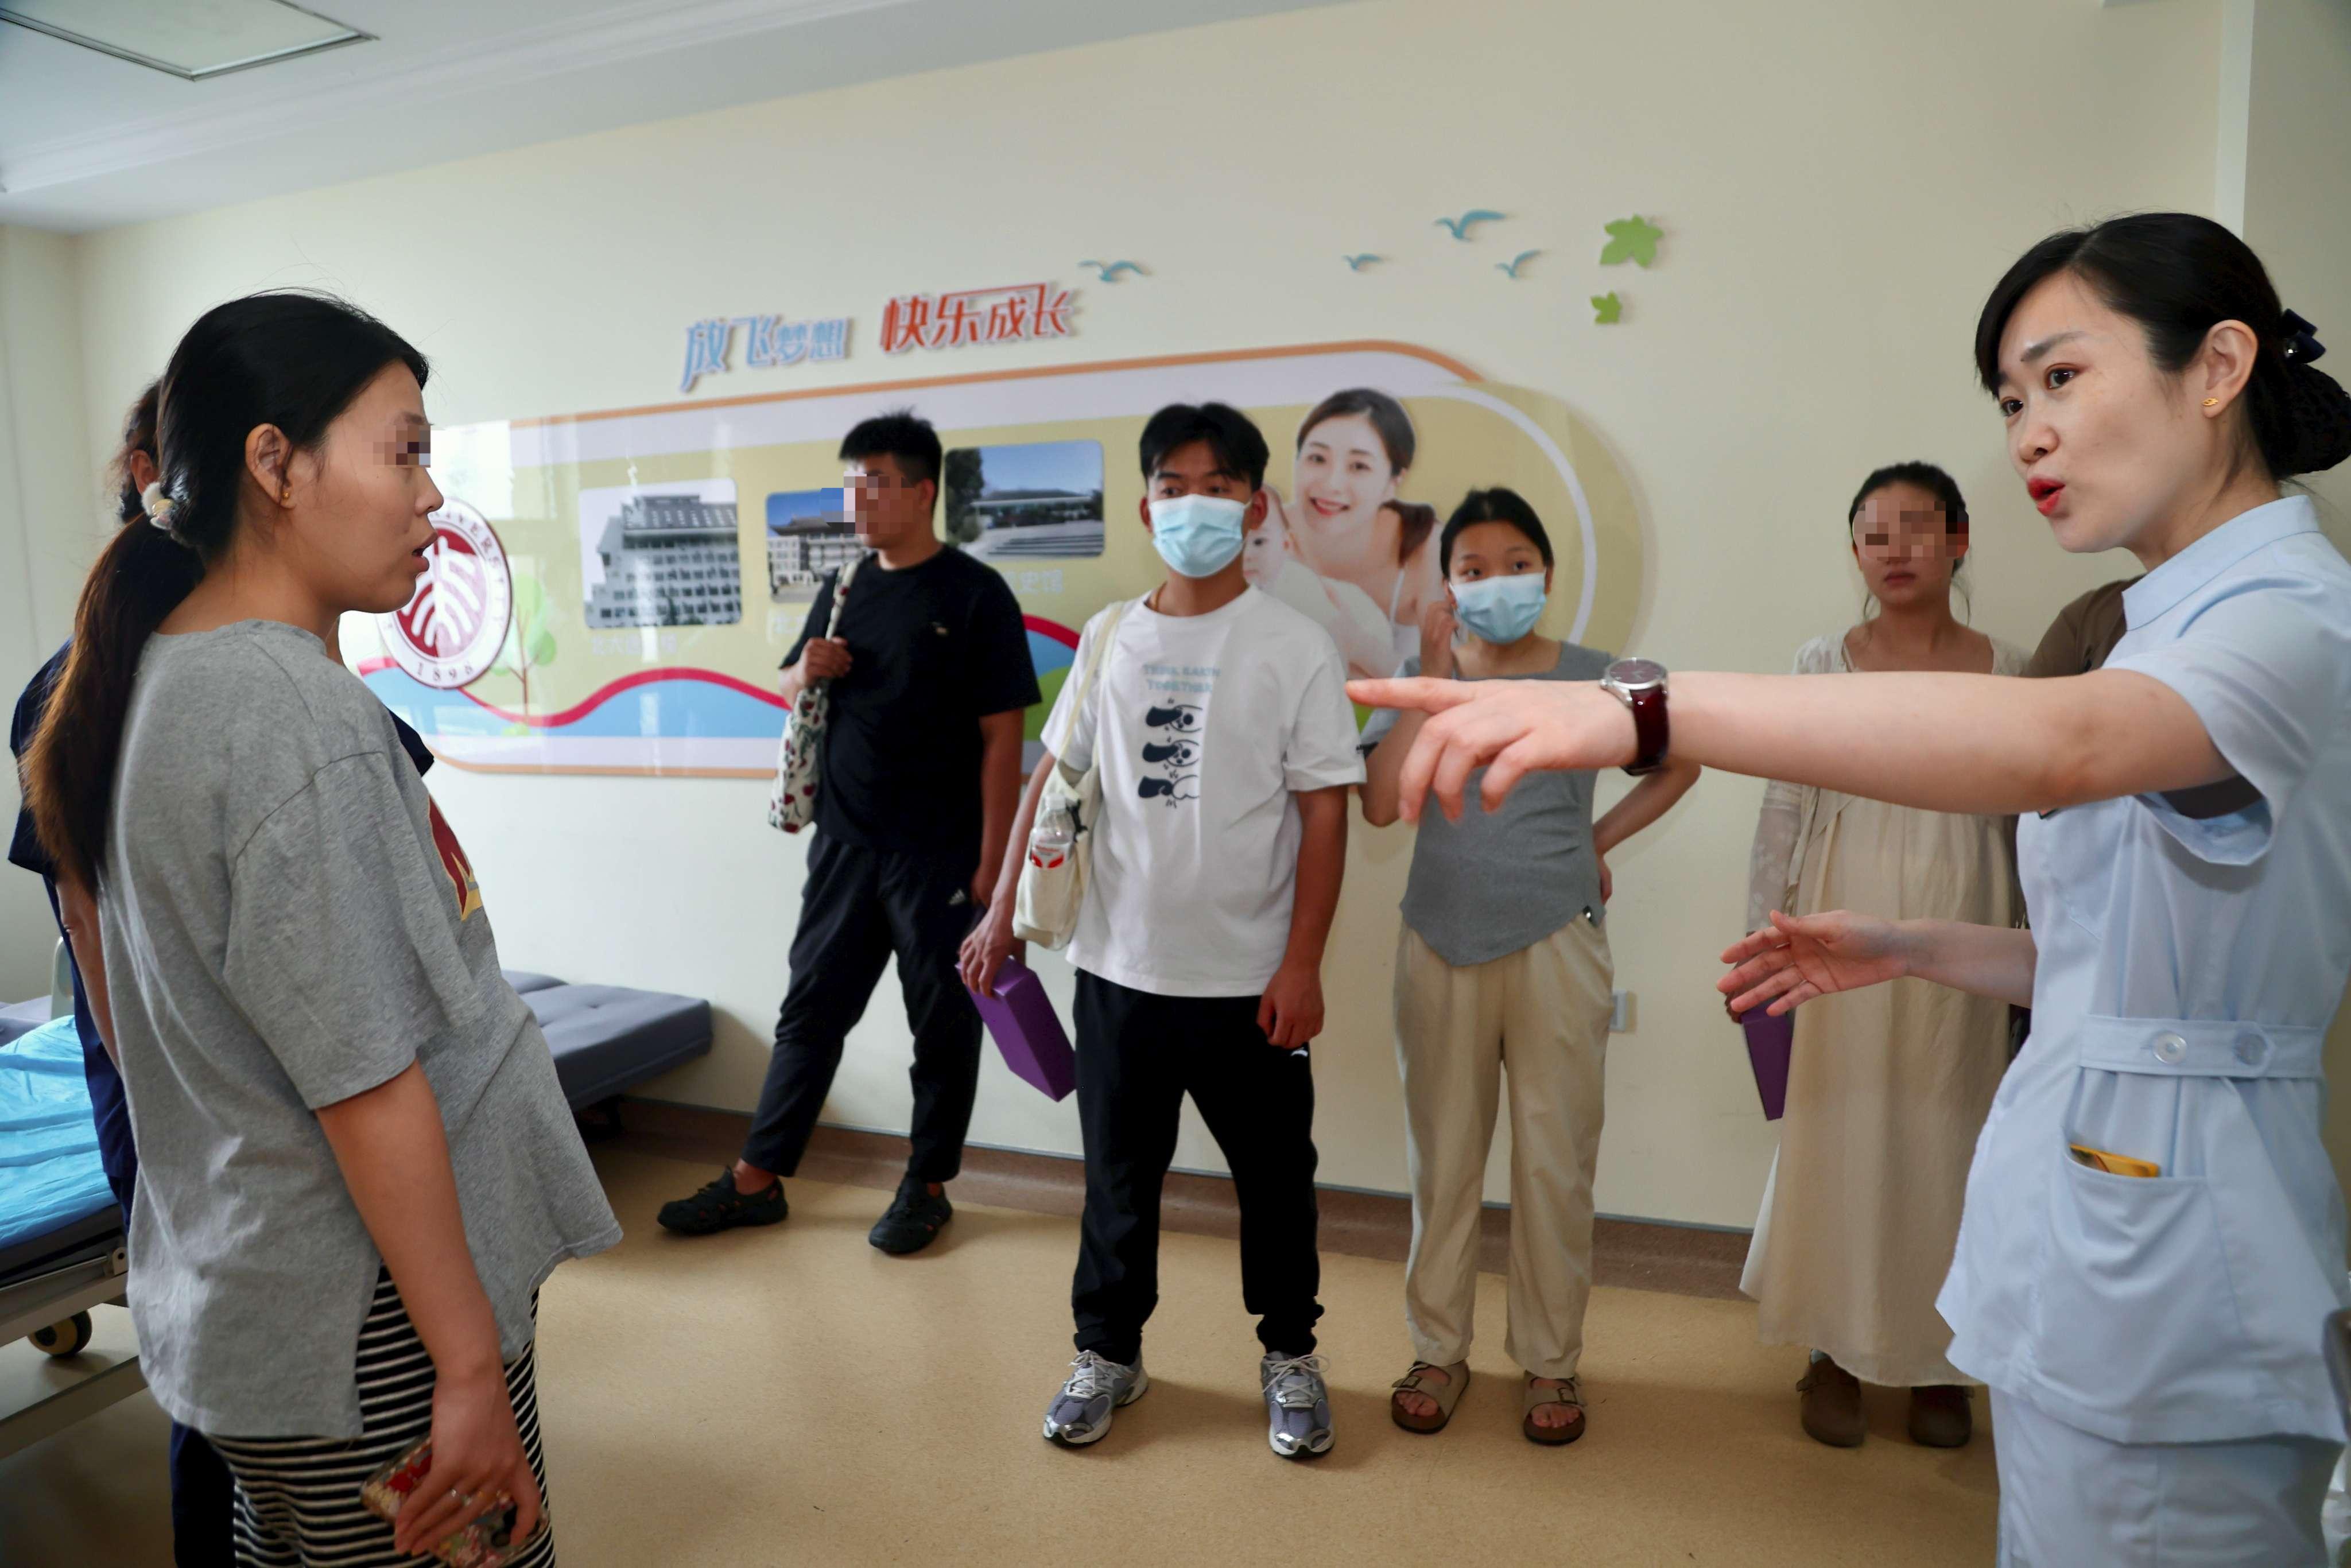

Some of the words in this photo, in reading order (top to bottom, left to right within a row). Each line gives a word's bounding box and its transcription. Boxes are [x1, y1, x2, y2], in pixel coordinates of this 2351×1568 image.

[681, 316, 849, 392] 放飞梦想
[880, 282, 1072, 353] 快乐成长
